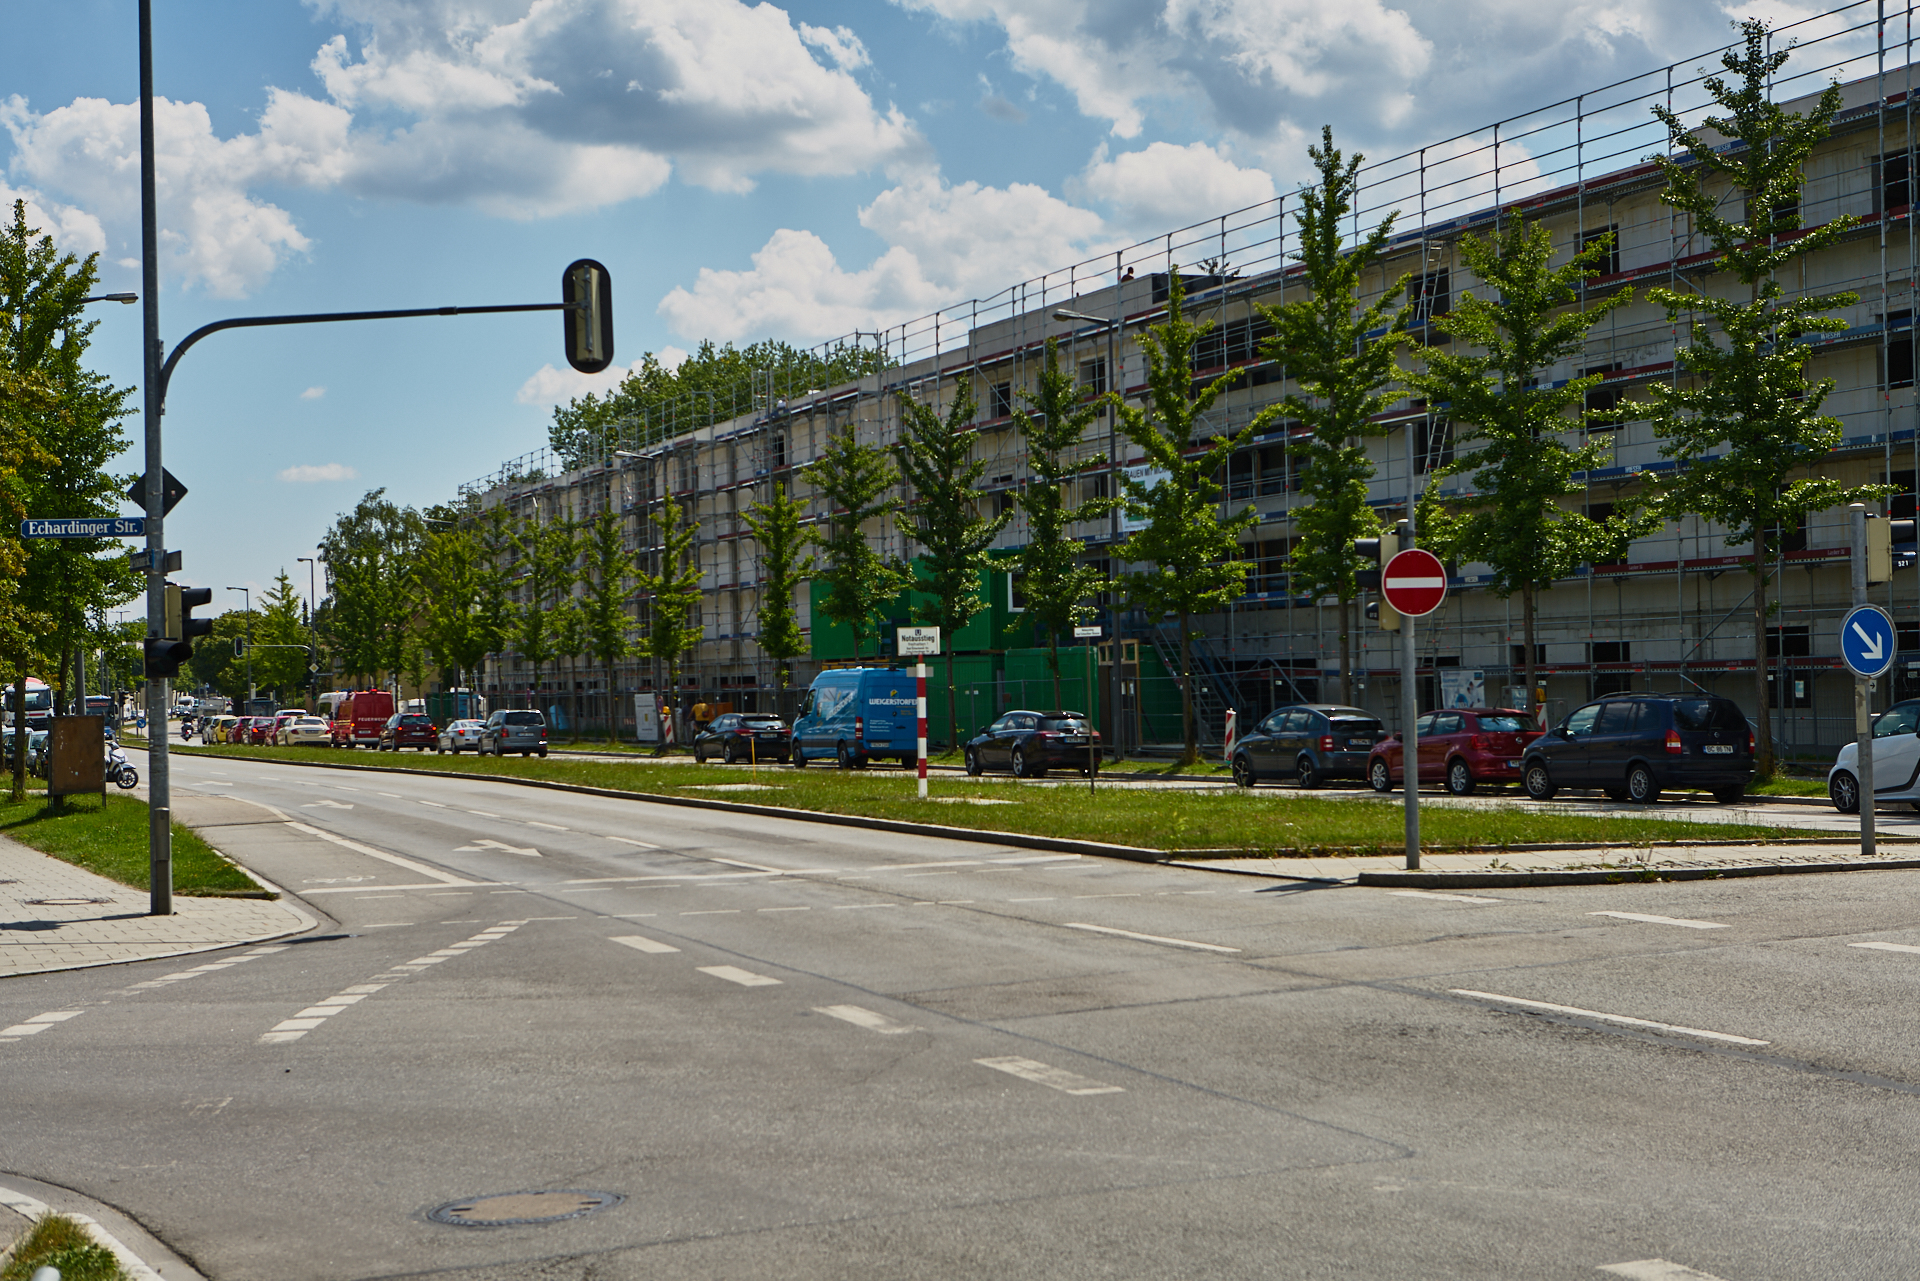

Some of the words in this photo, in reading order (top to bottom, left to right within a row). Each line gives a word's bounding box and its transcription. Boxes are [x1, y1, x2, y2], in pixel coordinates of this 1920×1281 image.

[29, 520, 110, 536] Echardinger
[115, 519, 138, 533] Str.
[901, 635, 935, 643] Notausstieg
